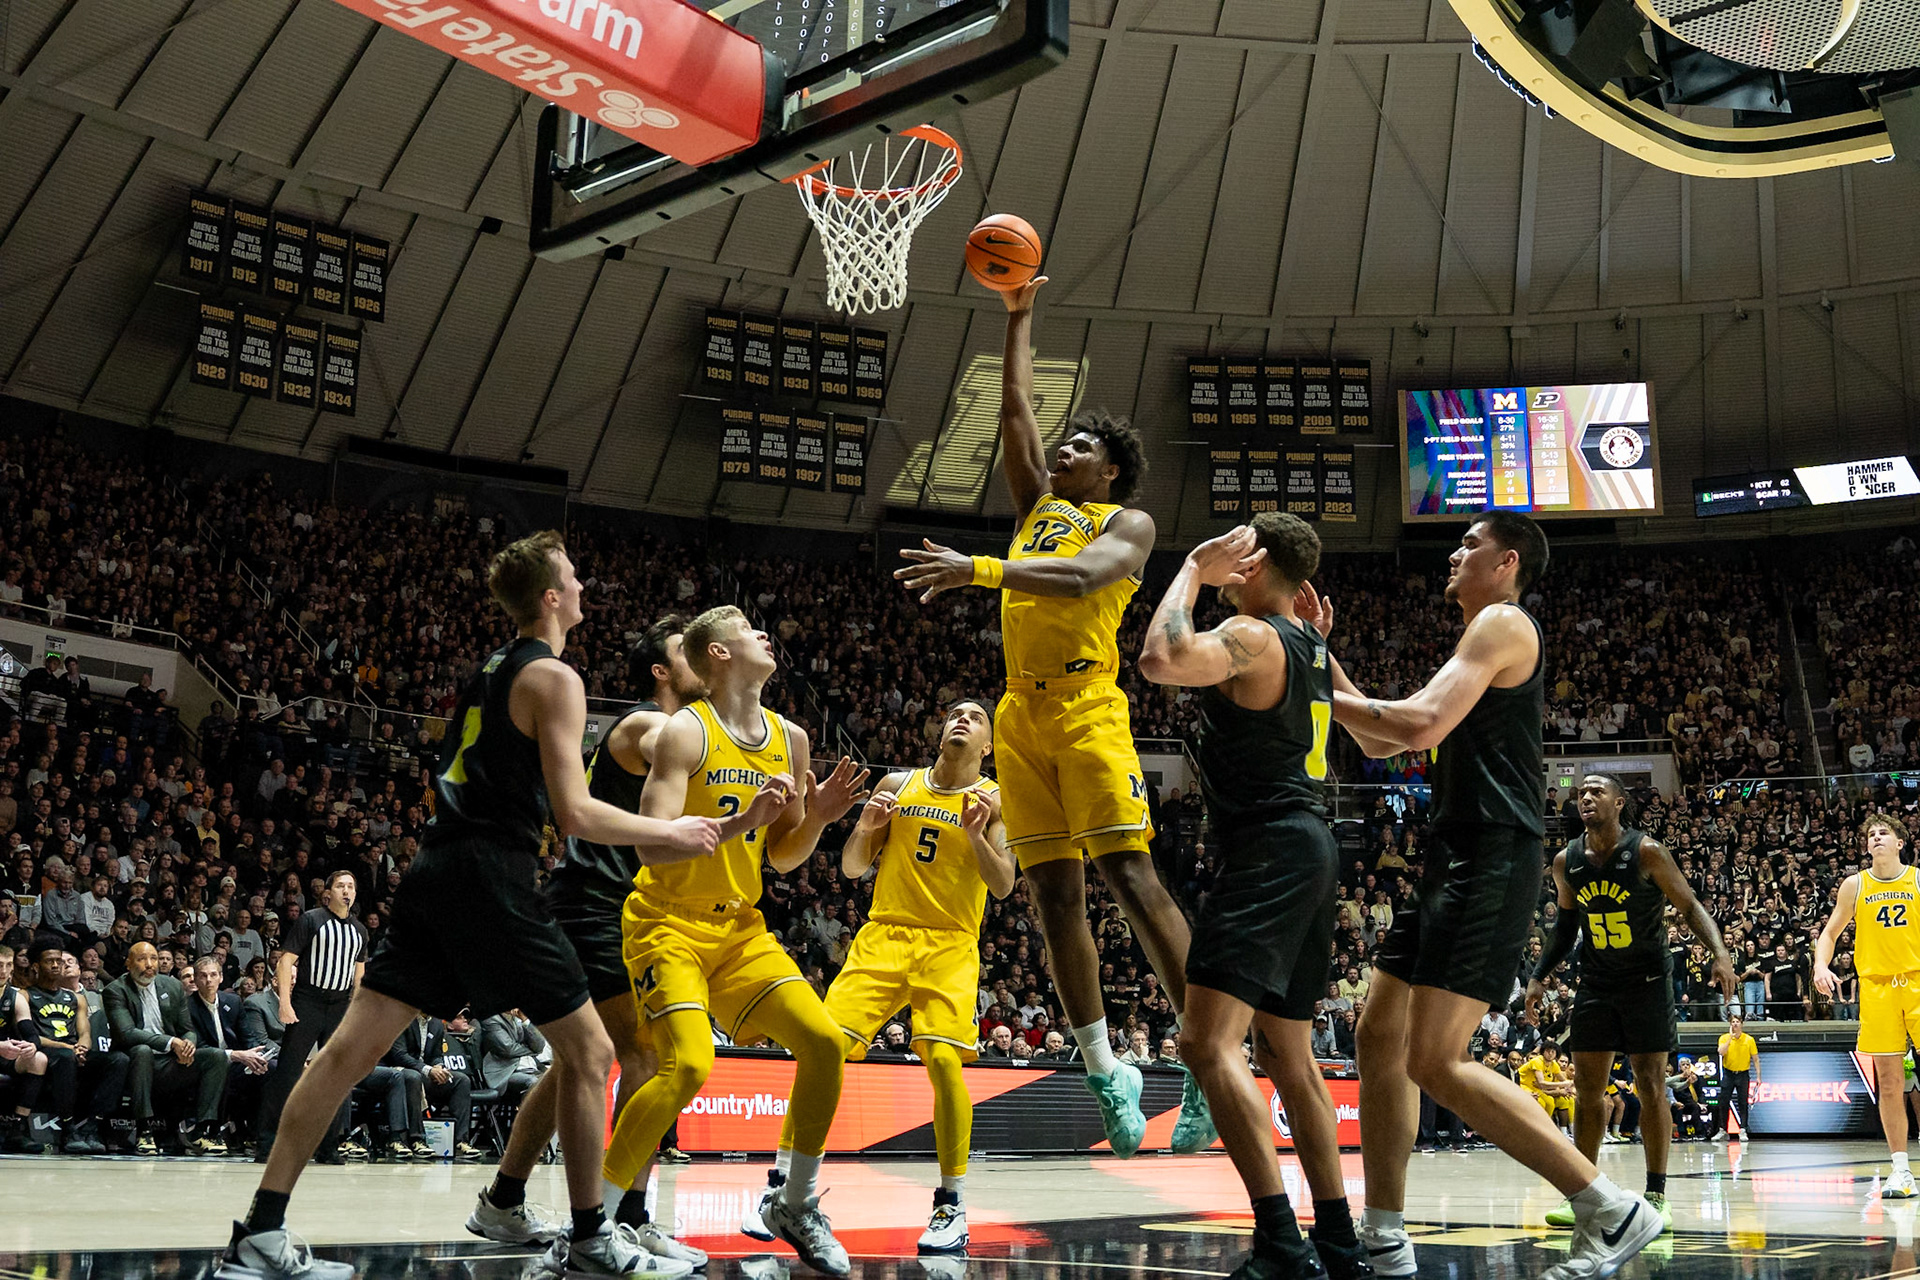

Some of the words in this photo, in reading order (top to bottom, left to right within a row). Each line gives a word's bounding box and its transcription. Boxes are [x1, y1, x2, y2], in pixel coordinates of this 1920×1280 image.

[234, 210, 267, 226] PURDUE
[187, 237, 219, 252] CHAMPS
[316, 232, 347, 247] PURDUE
[231, 247, 261, 262] CHAMPS
[189, 256, 212, 273] 1911
[273, 258, 302, 273] CHAMPS
[231, 266, 256, 283] 1912
[313, 268, 343, 283] CHAMPS
[273, 277, 298, 294] 1921
[353, 278, 382, 292] CHAMPS
[313, 286, 340, 304] 1922
[201, 303, 234, 320] PURDUE
[707, 316, 736, 328] PURDUE
[285, 324, 317, 339] PURDUE
[783, 327, 811, 338] PURDUE
[856, 336, 884, 347] PURDUE
[197, 342, 228, 358] CHAMPS
[706, 350, 733, 361] CHAMPS
[240, 352, 271, 367] CHAMPS
[743, 355, 771, 366] CHAMPS
[782, 360, 810, 370] CHAMPS
[282, 363, 314, 377] CHAMPS
[707, 366, 731, 380] 1935
[820, 365, 847, 375] CHAMPS
[856, 370, 882, 380] CHAMPS
[1227, 365, 1256, 373] PURDUE
[1301, 367, 1330, 375] PURDUE
[239, 371, 267, 390] 1930
[324, 371, 354, 385] CHAMPS
[283, 381, 310, 398] 1932
[323, 390, 351, 407] 1934
[1493, 393, 1518, 410] M
[1532, 392, 1561, 409] P
[759, 413, 789, 424] PURDUE
[1192, 413, 1217, 423] 1994
[1231, 413, 1256, 423] 1995
[1304, 415, 1331, 425] 2009
[835, 422, 864, 433] PURDUE
[722, 444, 750, 453] CHAMPS
[759, 448, 787, 458] CHAMPS
[795, 452, 823, 462] CHAMPS
[835, 456, 862, 466] CHAMPS
[1286, 452, 1314, 460] PURDUE
[1323, 453, 1351, 461] PURDUE
[723, 460, 749, 474] 1979
[760, 464, 785, 478] 1984
[1847, 462, 1894, 476] HAMMER
[796, 468, 820, 482] 1987
[836, 473, 861, 486] 1988
[1287, 485, 1315, 493] CHAMPS
[1849, 482, 1896, 497] CNCER
[1214, 500, 1239, 510] 2017
[1287, 501, 1315, 512] 2023
[1325, 502, 1352, 512] 2023
[1021, 519, 1072, 552] 32
[1036, 681, 1046, 690] M
[705, 768, 776, 788] MICHIG
[1128, 773, 1148, 802] M
[900, 806, 964, 828] MICHIGA
[916, 826, 940, 864] 5
[1576, 880, 1630, 908] PURDUE
[1864, 892, 1914, 904] MICHIGAN
[1876, 904, 1908, 928] 42
[1588, 911, 1633, 950] 55
[39, 1004, 75, 1018] PURDUE
[51, 1020, 69, 1038] 5
[1748, 1080, 1852, 1104] SEATGEEK
